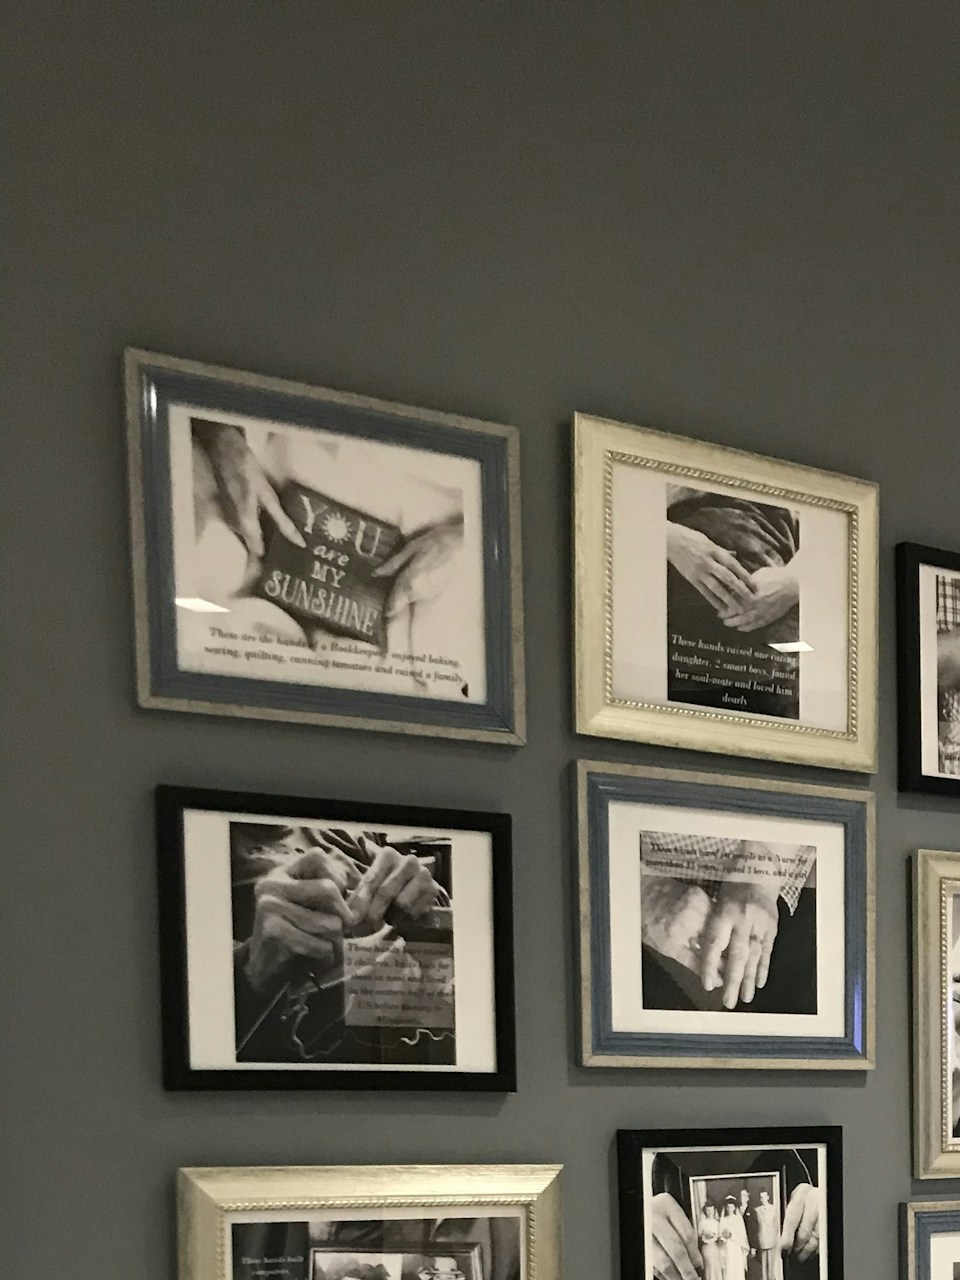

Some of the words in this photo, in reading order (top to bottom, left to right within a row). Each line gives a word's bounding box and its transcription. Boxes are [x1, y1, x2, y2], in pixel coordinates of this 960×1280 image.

[313, 545, 349, 566] are
[311, 561, 346, 588] MY
[264, 570, 378, 636] SUNSHINE
[209, 626, 238, 639] These
[241, 633, 256, 641] are
[259, 634, 272, 643] the
[277, 637, 307, 648] hands
[672, 634, 696, 647] These
[698, 639, 724, 652] hands
[726, 647, 752, 657] raised
[374, 666, 393, 674] and
[672, 652, 712, 667] daughter,
[715, 658, 721, 669] 2
[722, 662, 747, 672] smart
[771, 668, 796, 680] found
[675, 668, 689, 679] her
[734, 680, 751, 690] and
[753, 681, 774, 693] loved
[776, 685, 793, 696] him
